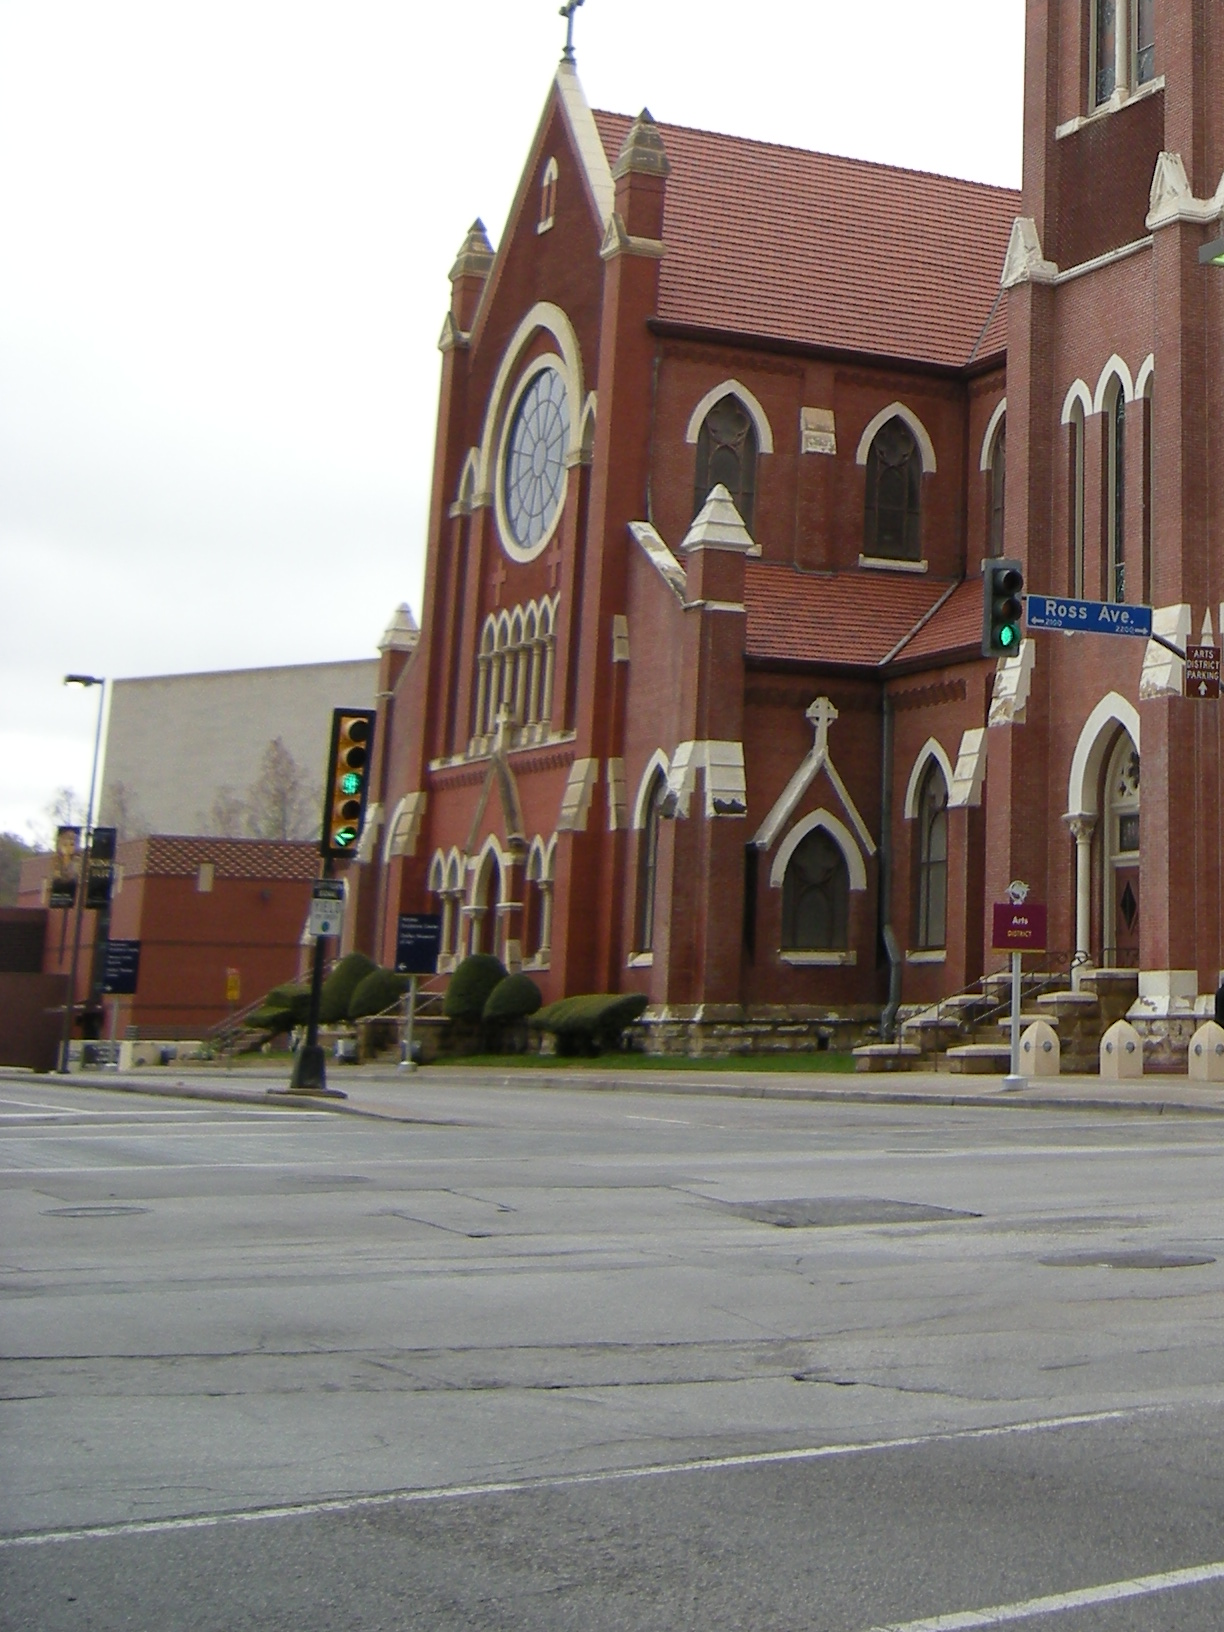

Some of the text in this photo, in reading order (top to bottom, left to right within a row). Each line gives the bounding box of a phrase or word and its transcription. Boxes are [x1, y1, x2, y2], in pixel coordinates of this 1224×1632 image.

[1045, 599, 1135, 625] Ross Ave.
[1115, 625, 1135, 634] 2200
[1193, 649, 1214, 659] ARTS
[1187, 659, 1220, 670] DISTRICT
[1186, 670, 1220, 680] PARKING
[1012, 915, 1029, 925] Arts
